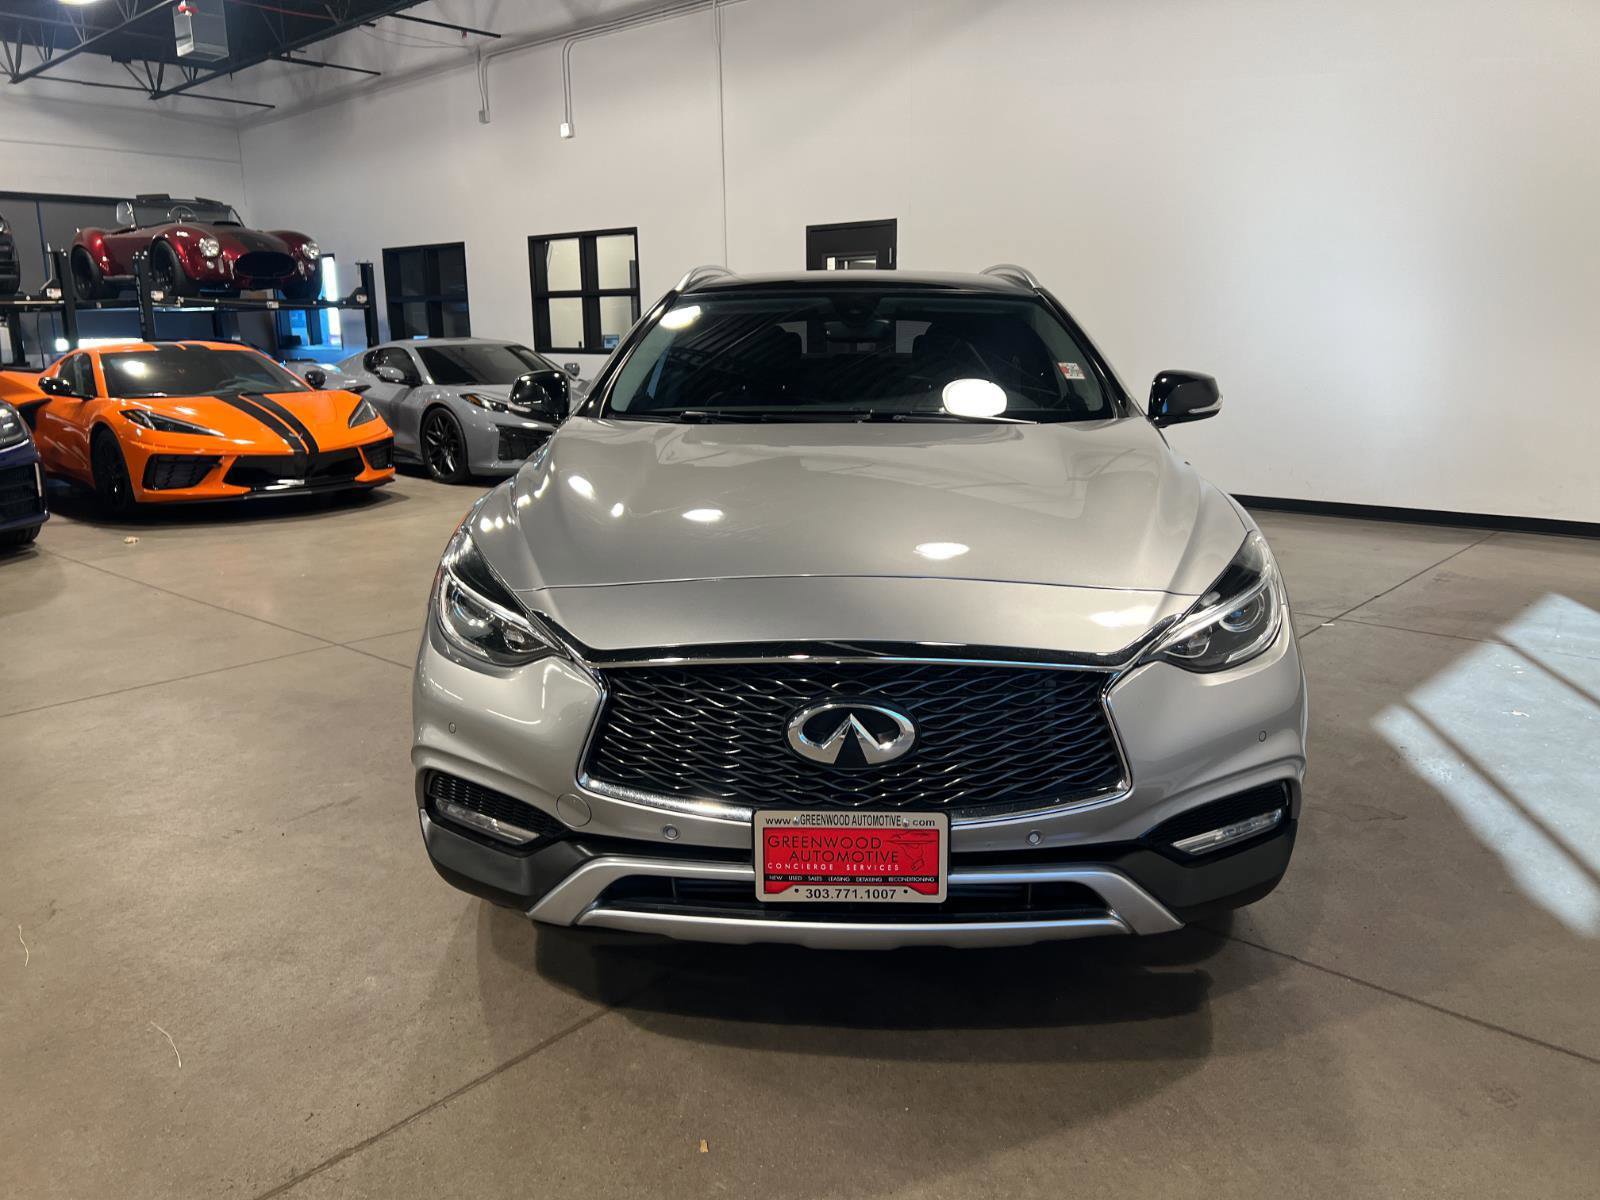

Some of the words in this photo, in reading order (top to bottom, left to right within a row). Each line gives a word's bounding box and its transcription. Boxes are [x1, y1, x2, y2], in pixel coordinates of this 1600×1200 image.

[800, 814, 850, 826] GREENWOOD
[852, 814, 901, 826] AUTOMOTIVE
[768, 835, 881, 849] GREENWOOD
[789, 850, 898, 862] AUTOMOTIVE
[767, 862, 833, 870] CONCIERGE
[806, 888, 897, 899] 303.771.1007
